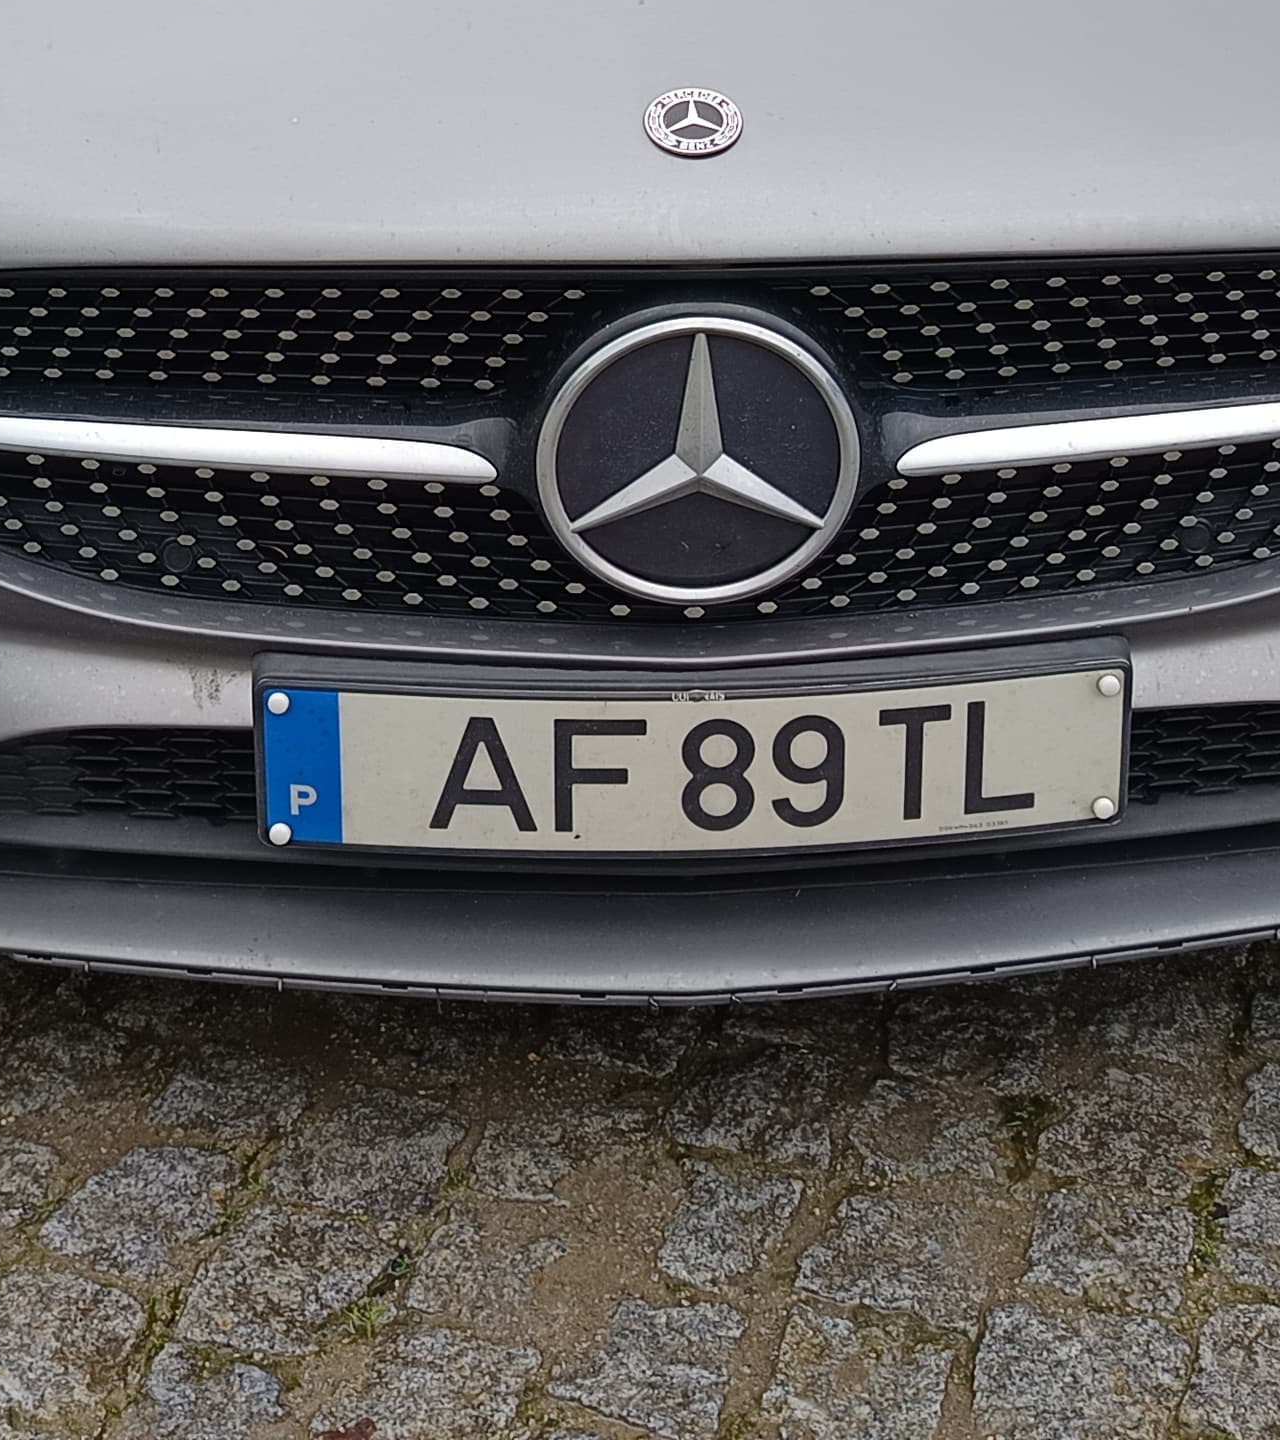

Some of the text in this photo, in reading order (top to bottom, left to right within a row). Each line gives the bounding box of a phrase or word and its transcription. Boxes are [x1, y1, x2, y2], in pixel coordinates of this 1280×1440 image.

[289, 783, 318, 816] P
[429, 700, 1036, 833] AF 89 TL
